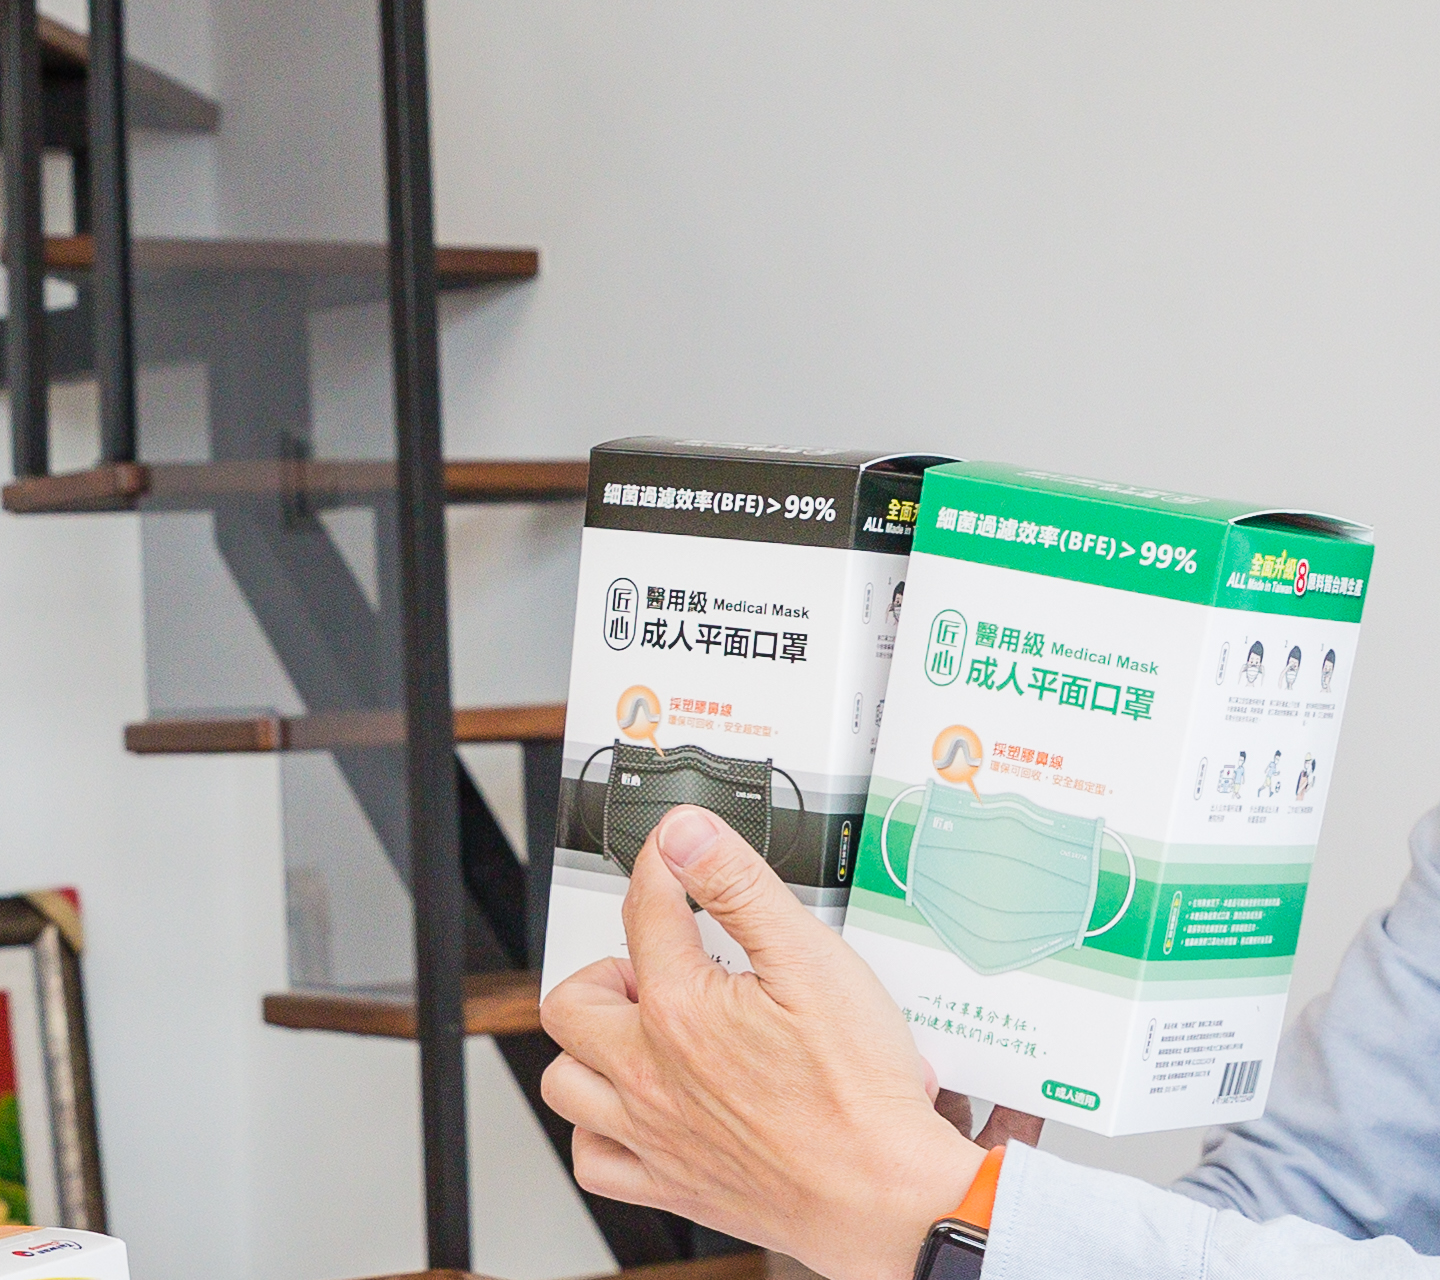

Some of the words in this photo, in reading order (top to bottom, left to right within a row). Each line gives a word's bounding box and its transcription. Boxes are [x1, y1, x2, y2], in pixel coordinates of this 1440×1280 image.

[863, 516, 885, 533] ALL
[1226, 572, 1247, 589] ALL
[1293, 558, 1309, 596] 8
[646, 585, 708, 614] 醫用級
[713, 598, 768, 615] Medical
[772, 603, 810, 620] Mask
[640, 618, 809, 664] 成人平面口罩
[975, 621, 1045, 658] 醫用級
[1051, 642, 1112, 666] Medical
[1116, 655, 1159, 676] Mask
[965, 656, 1156, 721] 成人平面口罩
[1046, 1083, 1053, 1096] L
